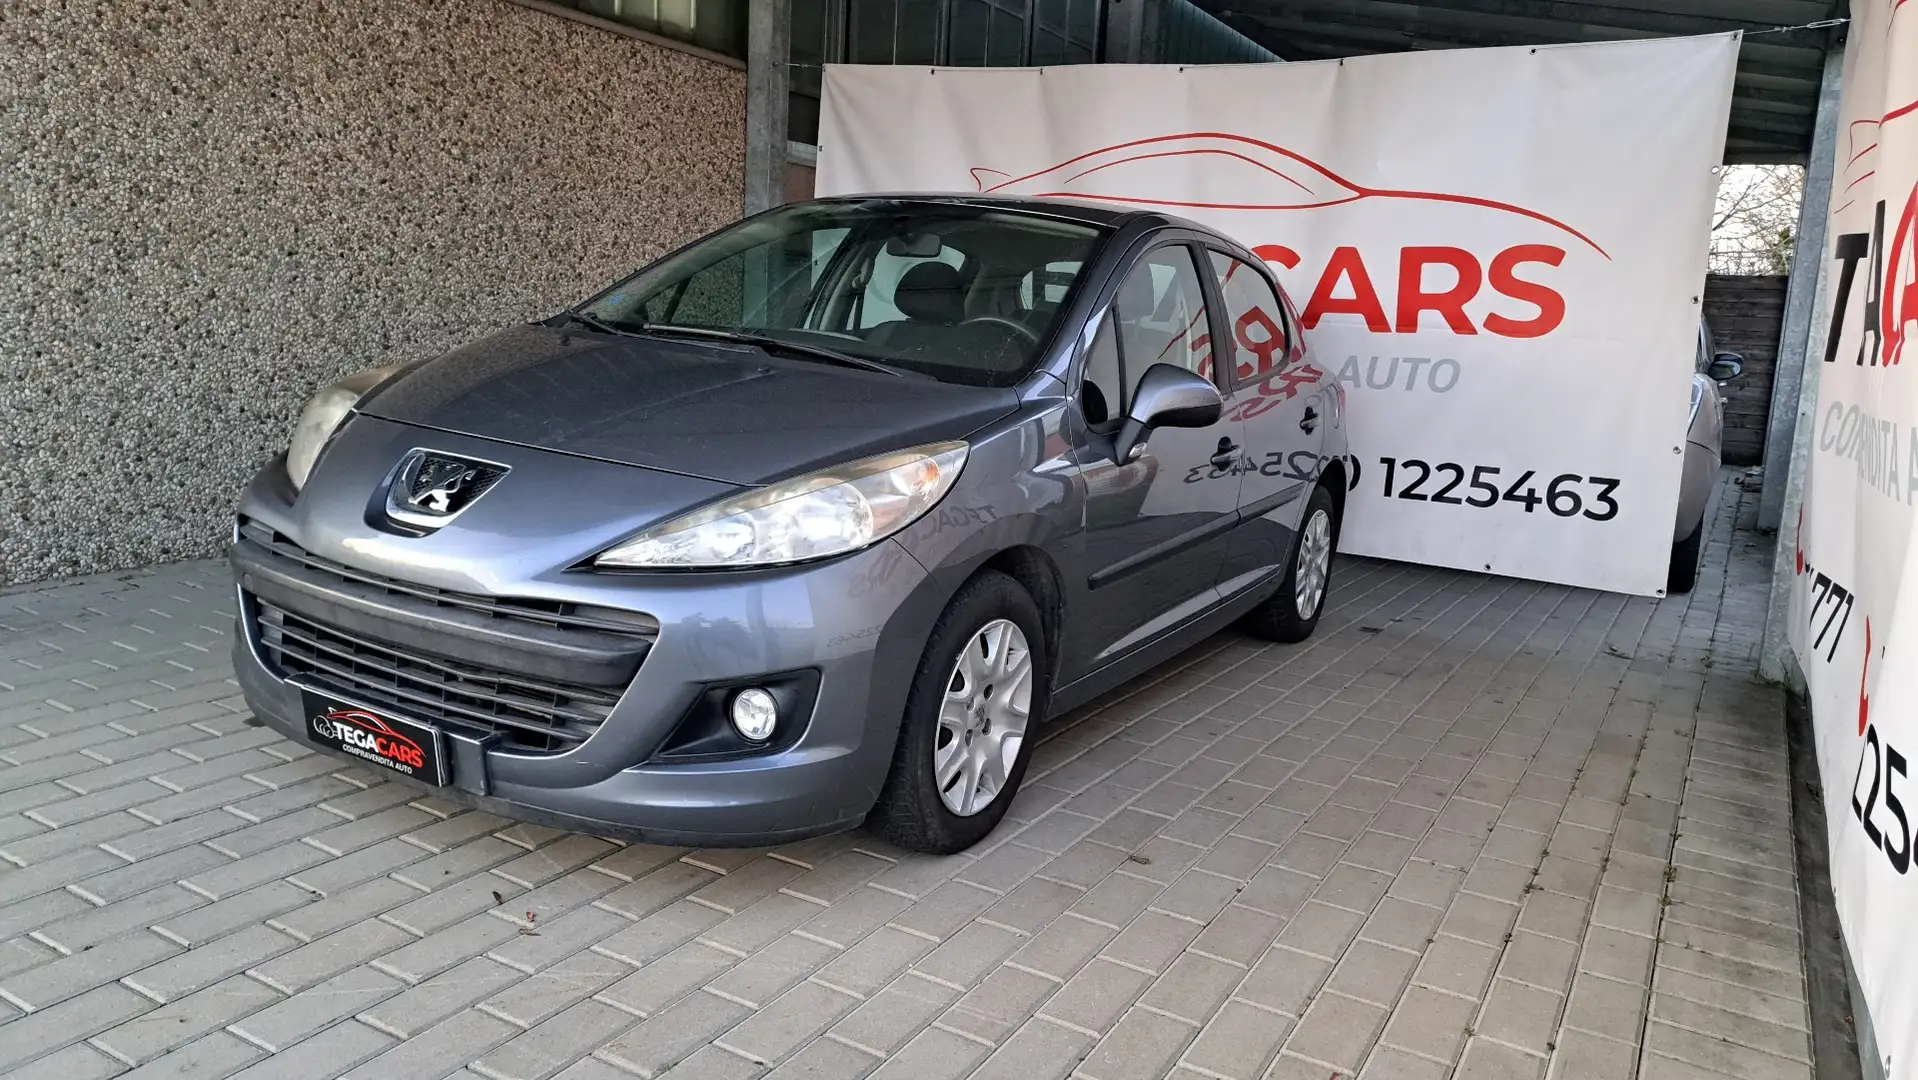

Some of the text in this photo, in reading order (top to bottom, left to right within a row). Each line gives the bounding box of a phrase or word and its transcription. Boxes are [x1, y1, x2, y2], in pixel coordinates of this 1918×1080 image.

[1251, 244, 1566, 338] ARS
[1336, 353, 1461, 394] AUTO
[1379, 456, 1621, 522] 1225463
[332, 721, 423, 768] TEGACARS
[342, 743, 413, 774] COMPRAVENDITA AUTO
